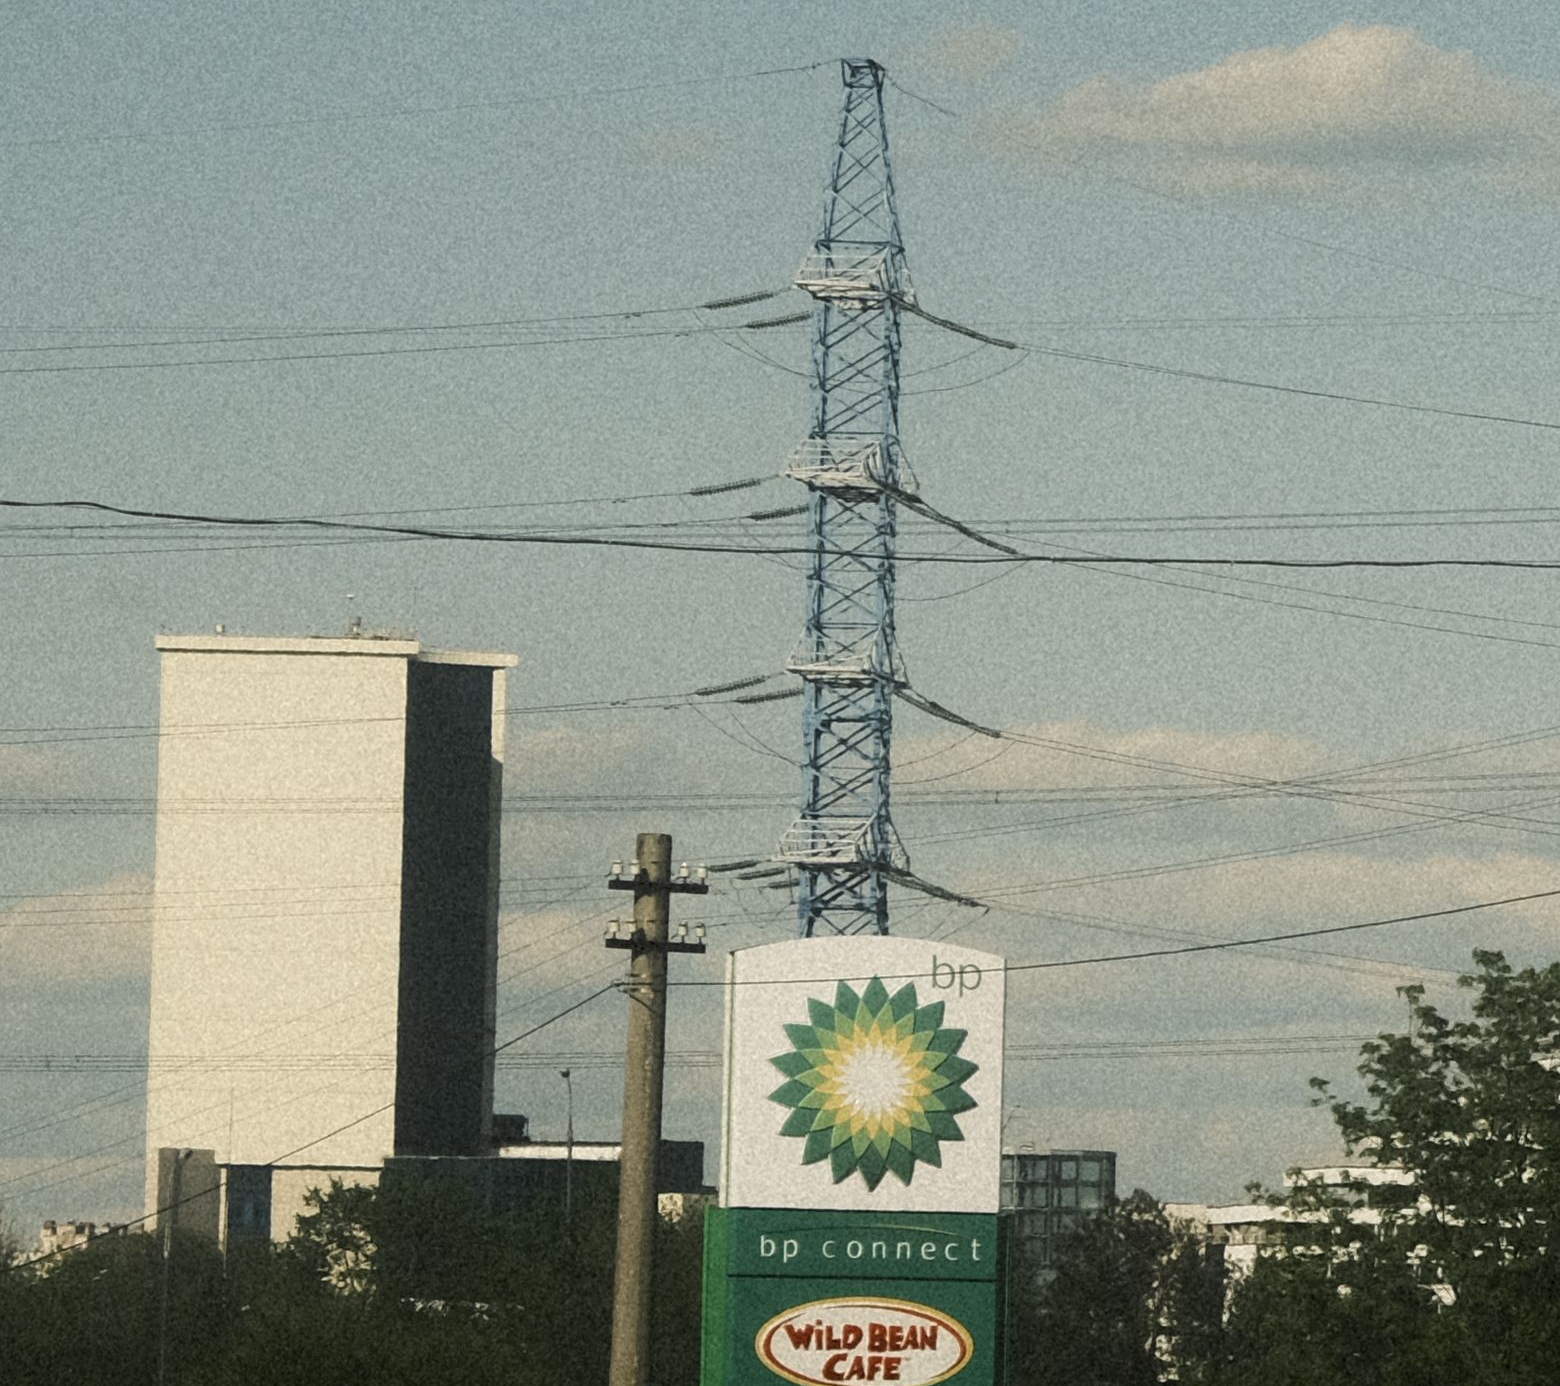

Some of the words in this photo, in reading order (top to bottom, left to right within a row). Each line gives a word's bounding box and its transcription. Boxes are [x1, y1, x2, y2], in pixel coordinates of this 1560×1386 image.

[931, 954, 982, 998] bp
[760, 1235, 799, 1263] bp
[821, 1237, 983, 1262] connect
[867, 1322, 940, 1353] BEAN
[821, 1352, 903, 1382] CAFE
